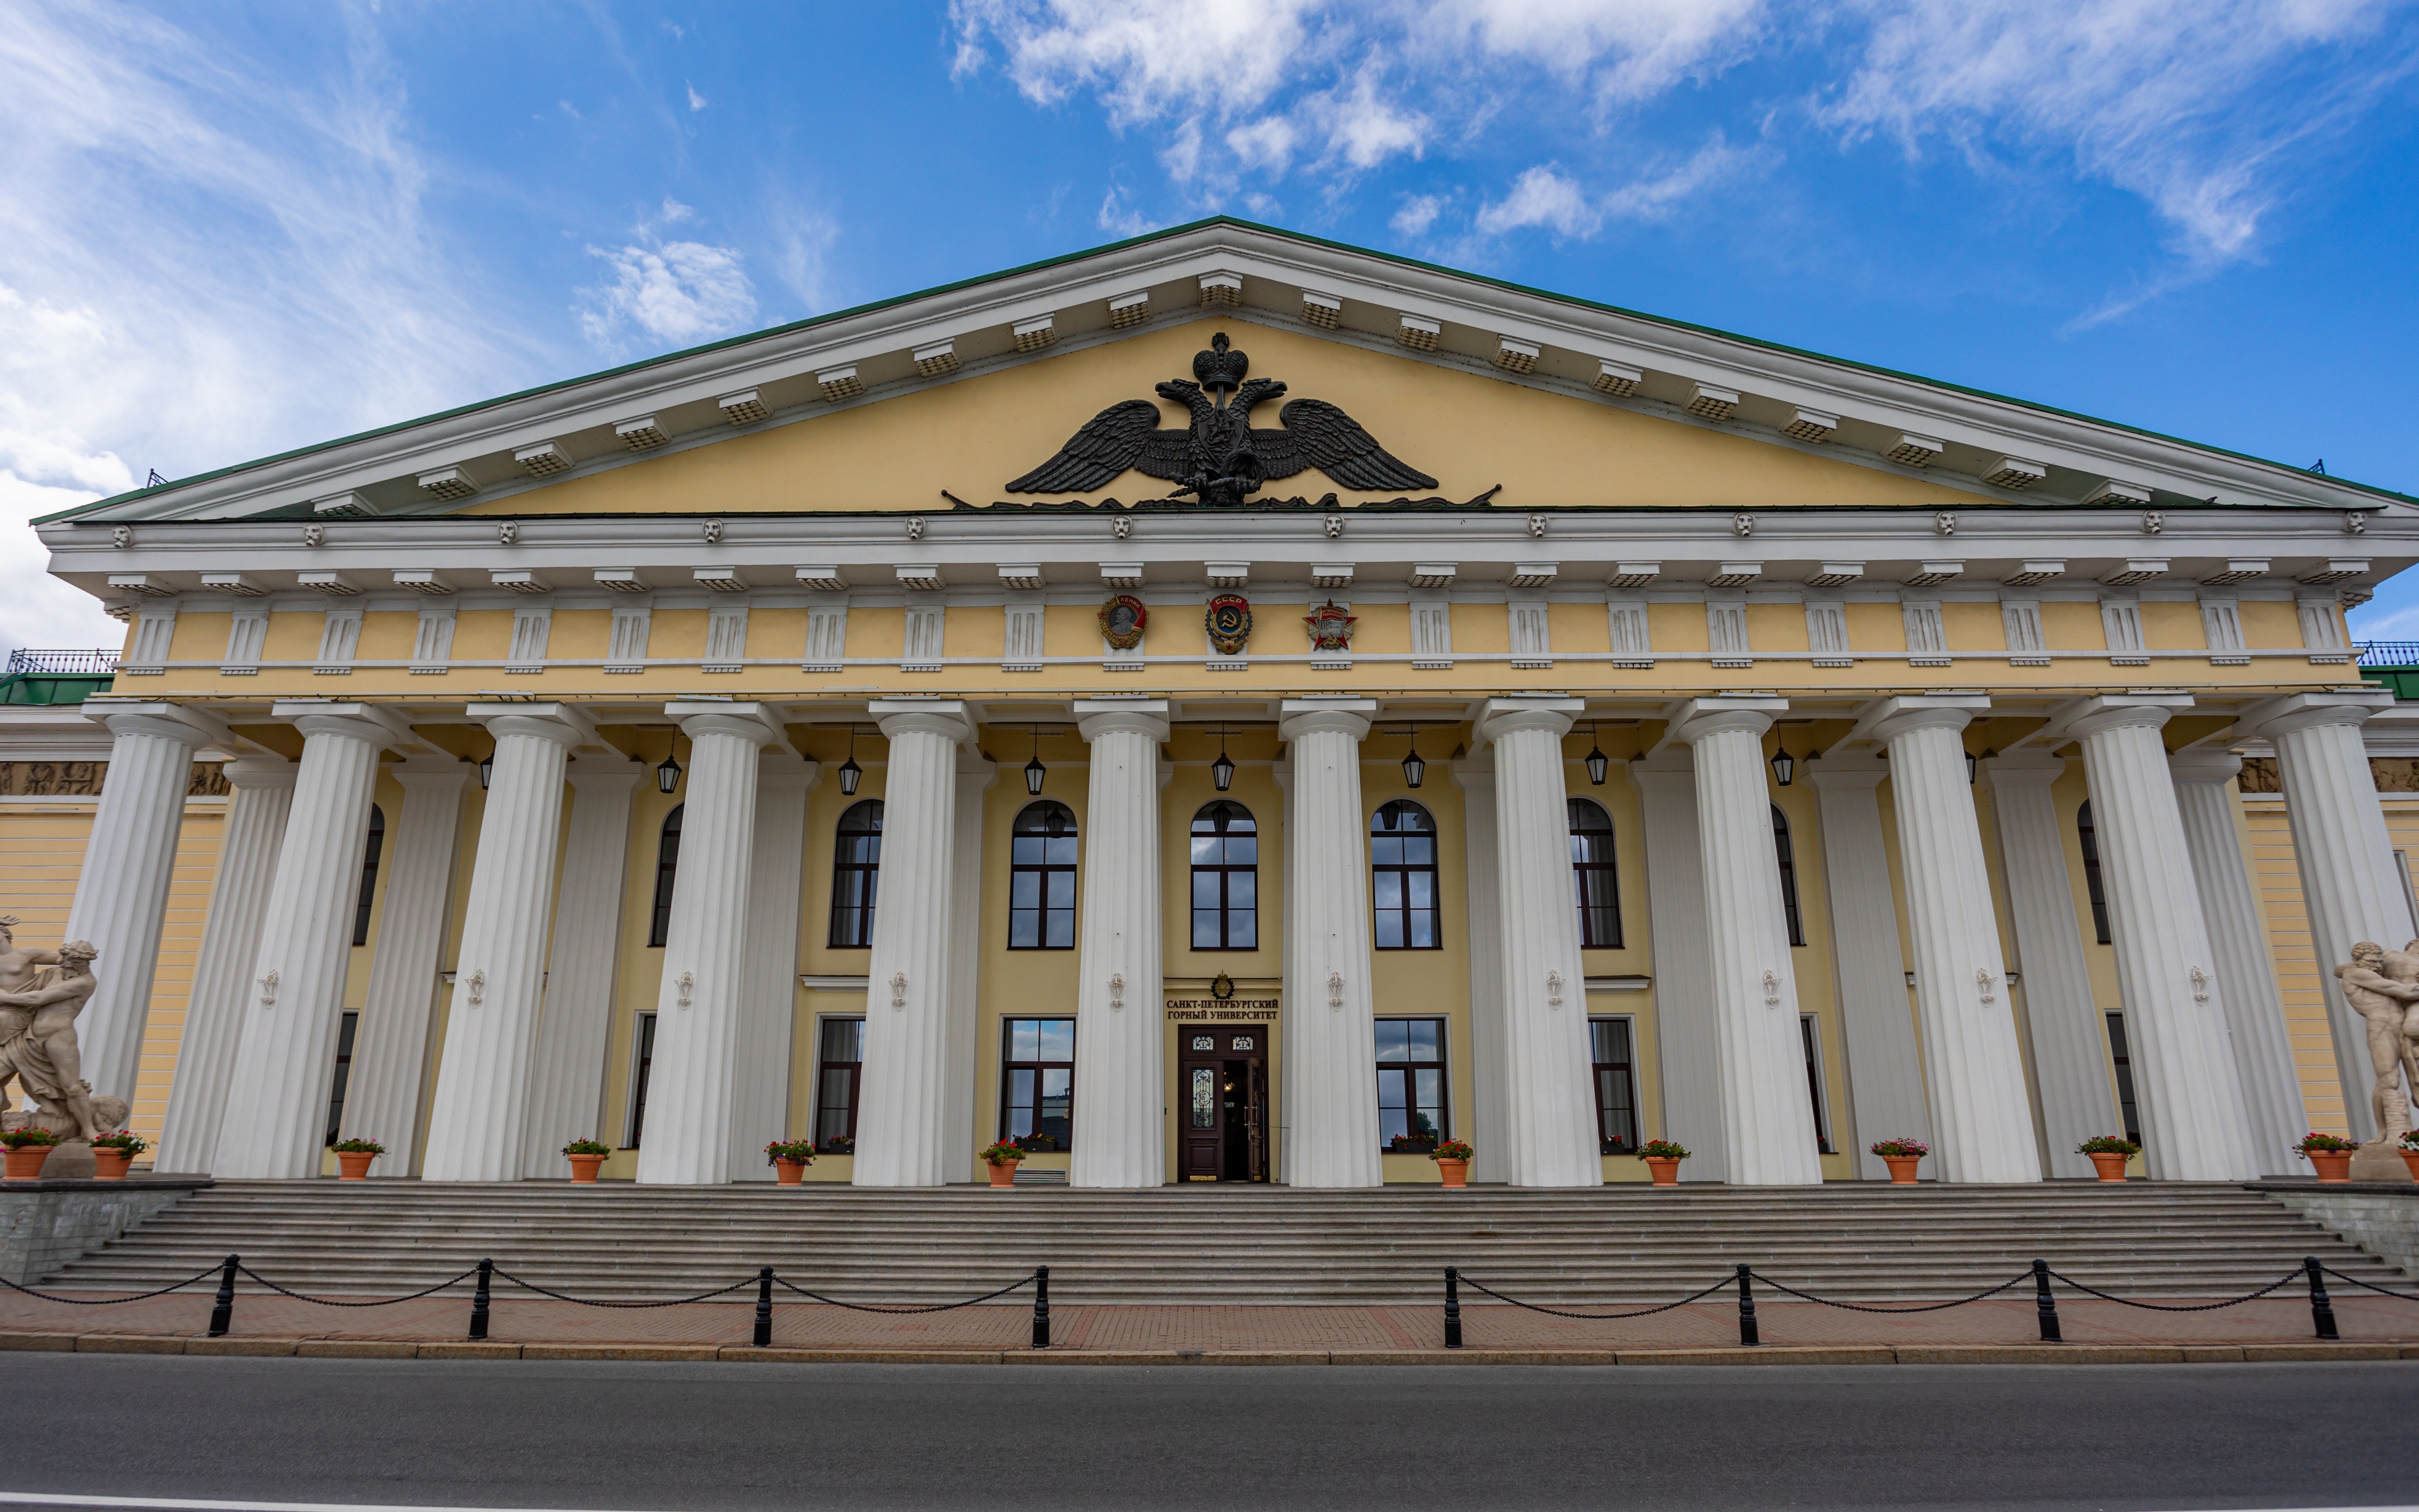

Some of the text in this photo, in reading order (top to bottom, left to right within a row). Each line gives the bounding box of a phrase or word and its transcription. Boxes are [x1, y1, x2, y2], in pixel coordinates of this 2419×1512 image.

[1121, 598, 1141, 608] ЛЕНИН
[1166, 999, 1279, 1008] САНКТ-ПЕТЕРБУРГСКИЙ
[1168, 1009, 1278, 1019] ГОРНЫЙ УНИВЕРСИТЕТ
